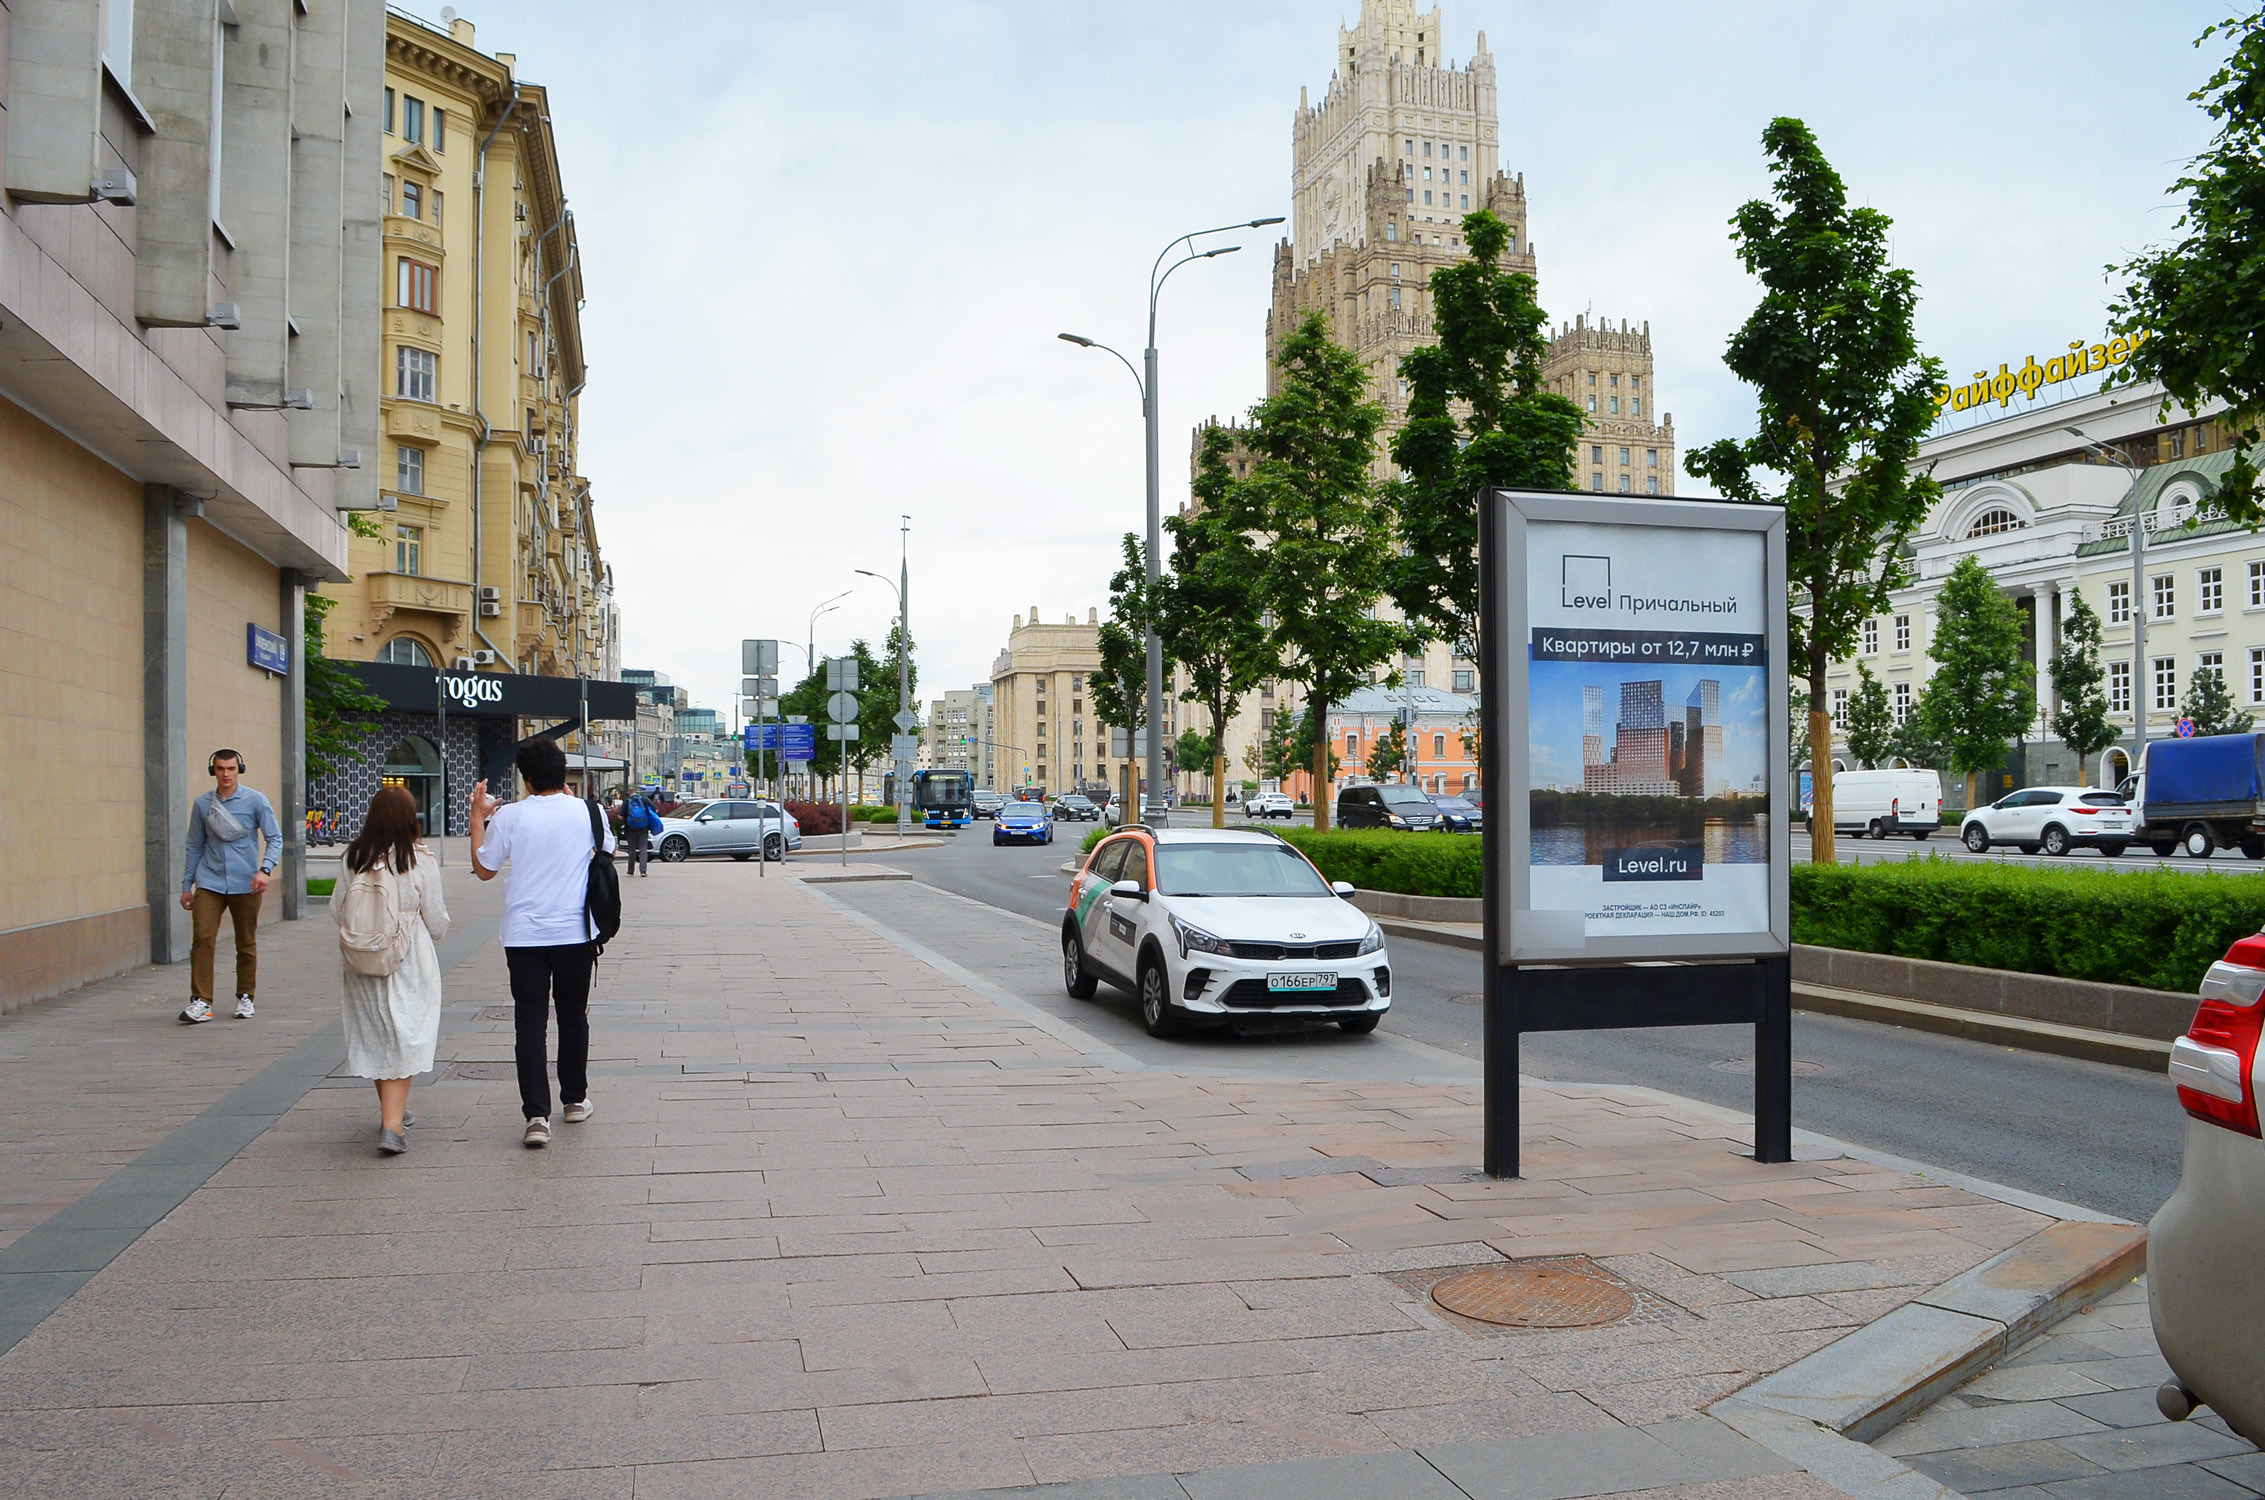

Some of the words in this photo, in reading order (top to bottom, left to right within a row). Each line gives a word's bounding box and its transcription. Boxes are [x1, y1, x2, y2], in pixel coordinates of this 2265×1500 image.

[1562, 587, 1611, 609] Level
[1620, 595, 1737, 615] Причальный
[1543, 637, 1635, 659] Квартиры
[1641, 642, 1662, 655] от
[1667, 640, 1700, 659] 12,7
[1705, 643, 1739, 657] млн
[1618, 857, 1687, 873] Level.ru
[1584, 912, 1614, 920] РОЕКТНАЯ
[1615, 911, 1654, 919] ДЕКЛАРАЦИЯ
[1602, 903, 1642, 912] ЗАСТРОЙЩИК
[1318, 973, 1335, 984] 797
